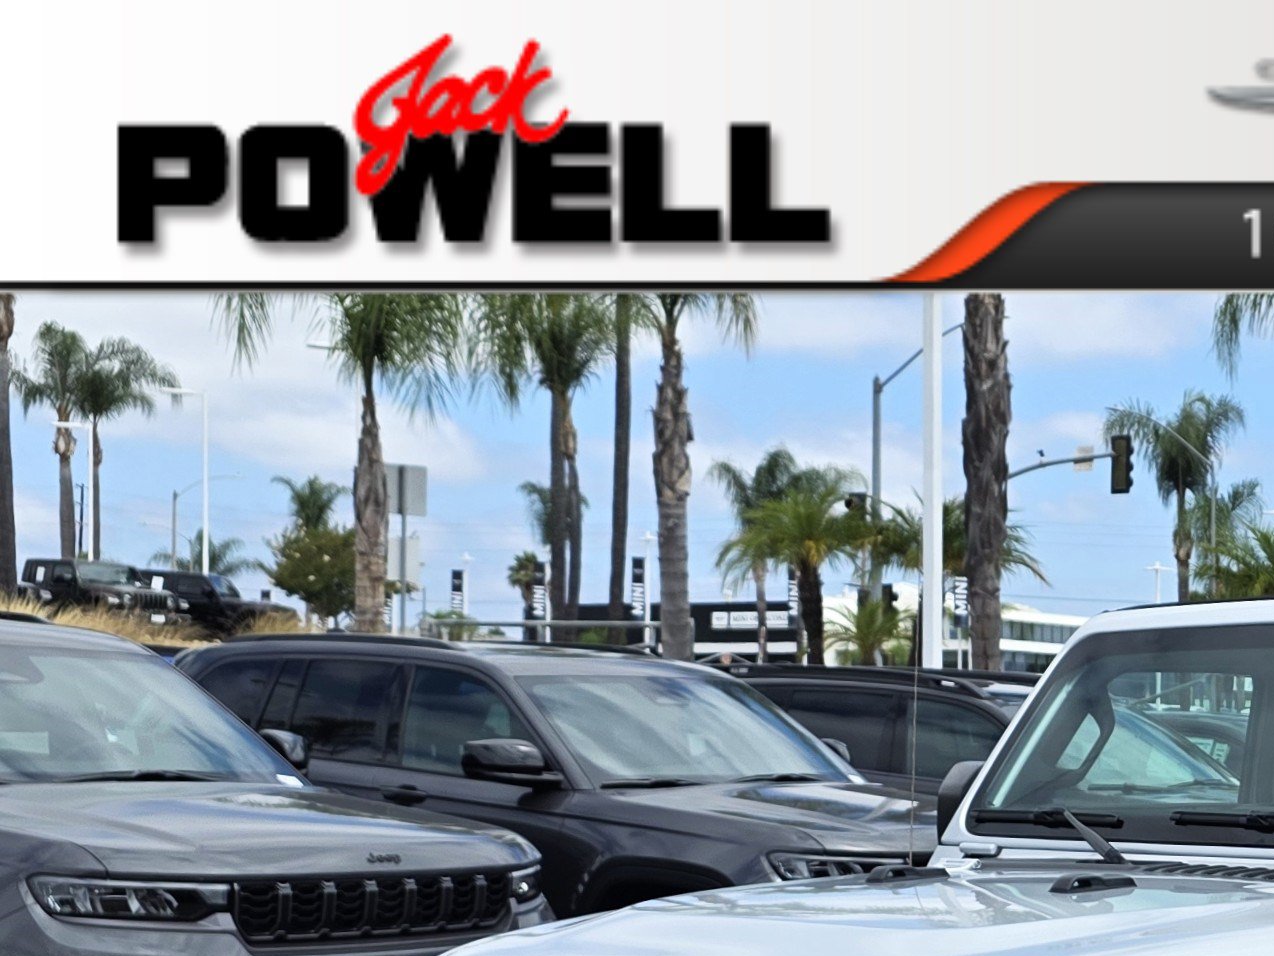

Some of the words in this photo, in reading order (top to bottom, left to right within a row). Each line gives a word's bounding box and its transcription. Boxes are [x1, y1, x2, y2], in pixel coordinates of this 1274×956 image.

[532, 585, 546, 617] MINI
[630, 582, 645, 616] MINI
[788, 579, 799, 616] MINI
[953, 576, 968, 615] MINI
[366, 852, 402, 865] Jeep
